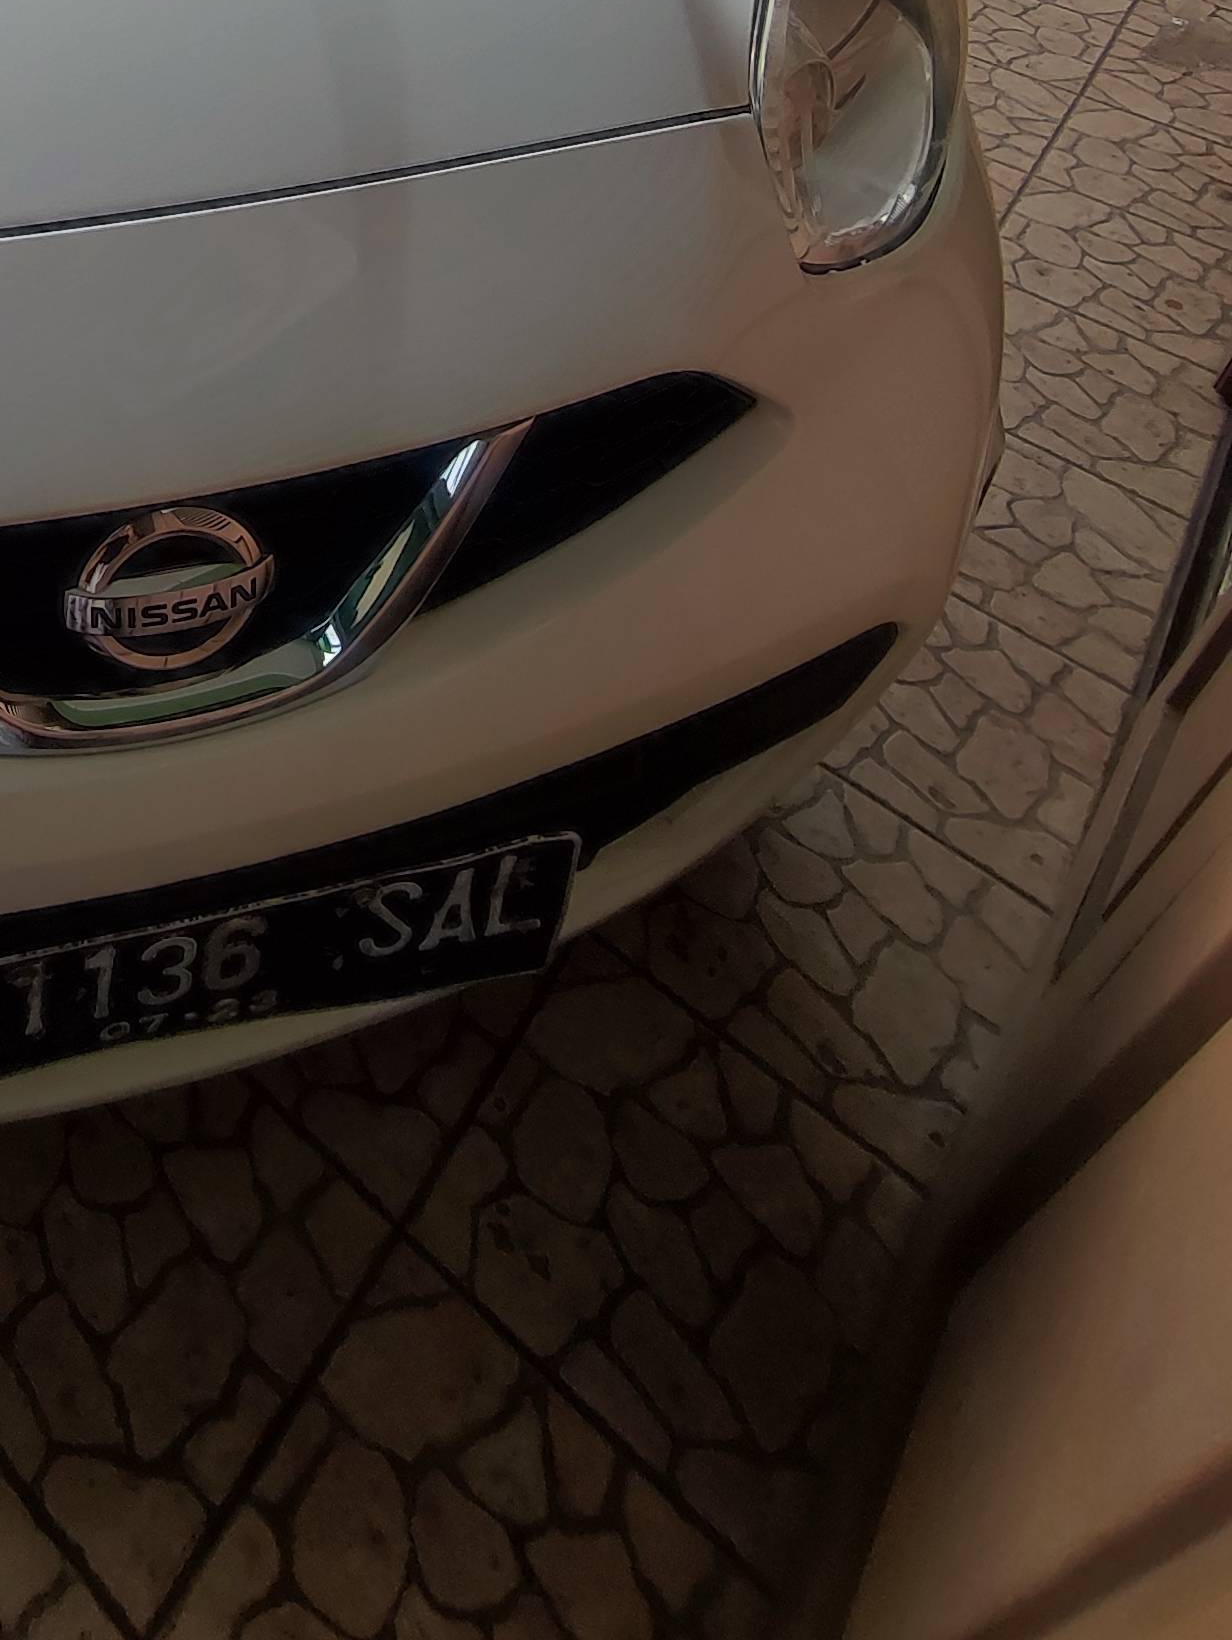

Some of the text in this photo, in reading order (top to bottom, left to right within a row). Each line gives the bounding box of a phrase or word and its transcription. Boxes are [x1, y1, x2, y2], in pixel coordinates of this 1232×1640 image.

[90, 576, 257, 629] NISSAN
[4, 915, 269, 1036] 1136
[354, 855, 542, 957] SAL
